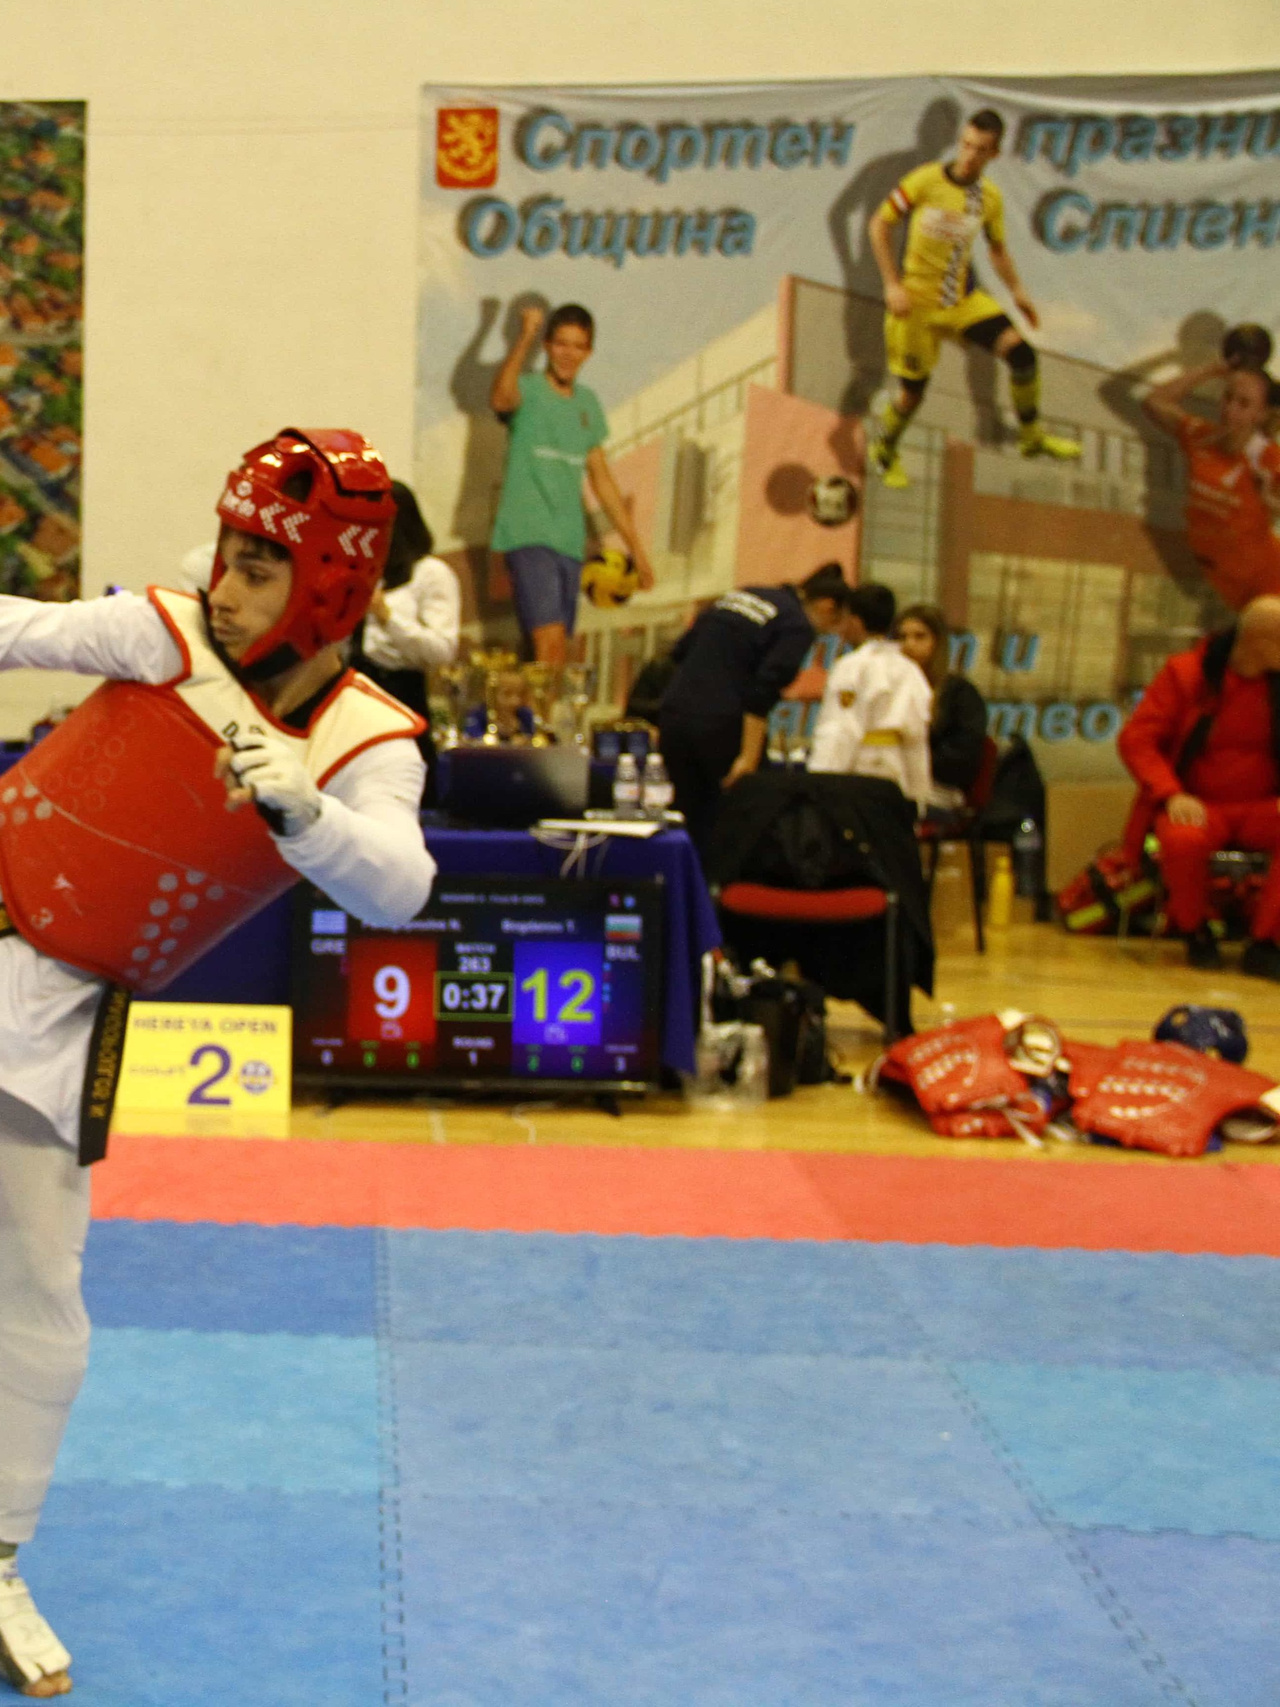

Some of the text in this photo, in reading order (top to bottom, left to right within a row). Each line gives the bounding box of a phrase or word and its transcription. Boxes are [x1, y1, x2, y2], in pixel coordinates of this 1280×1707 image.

[520, 110, 856, 185] Спортен
[464, 196, 758, 270] Община
[373, 965, 411, 1020] 9
[442, 982, 506, 1010] 0:37
[521, 967, 595, 1022] 12
[219, 1017, 278, 1036] OPEN
[187, 1042, 232, 1106] 2
